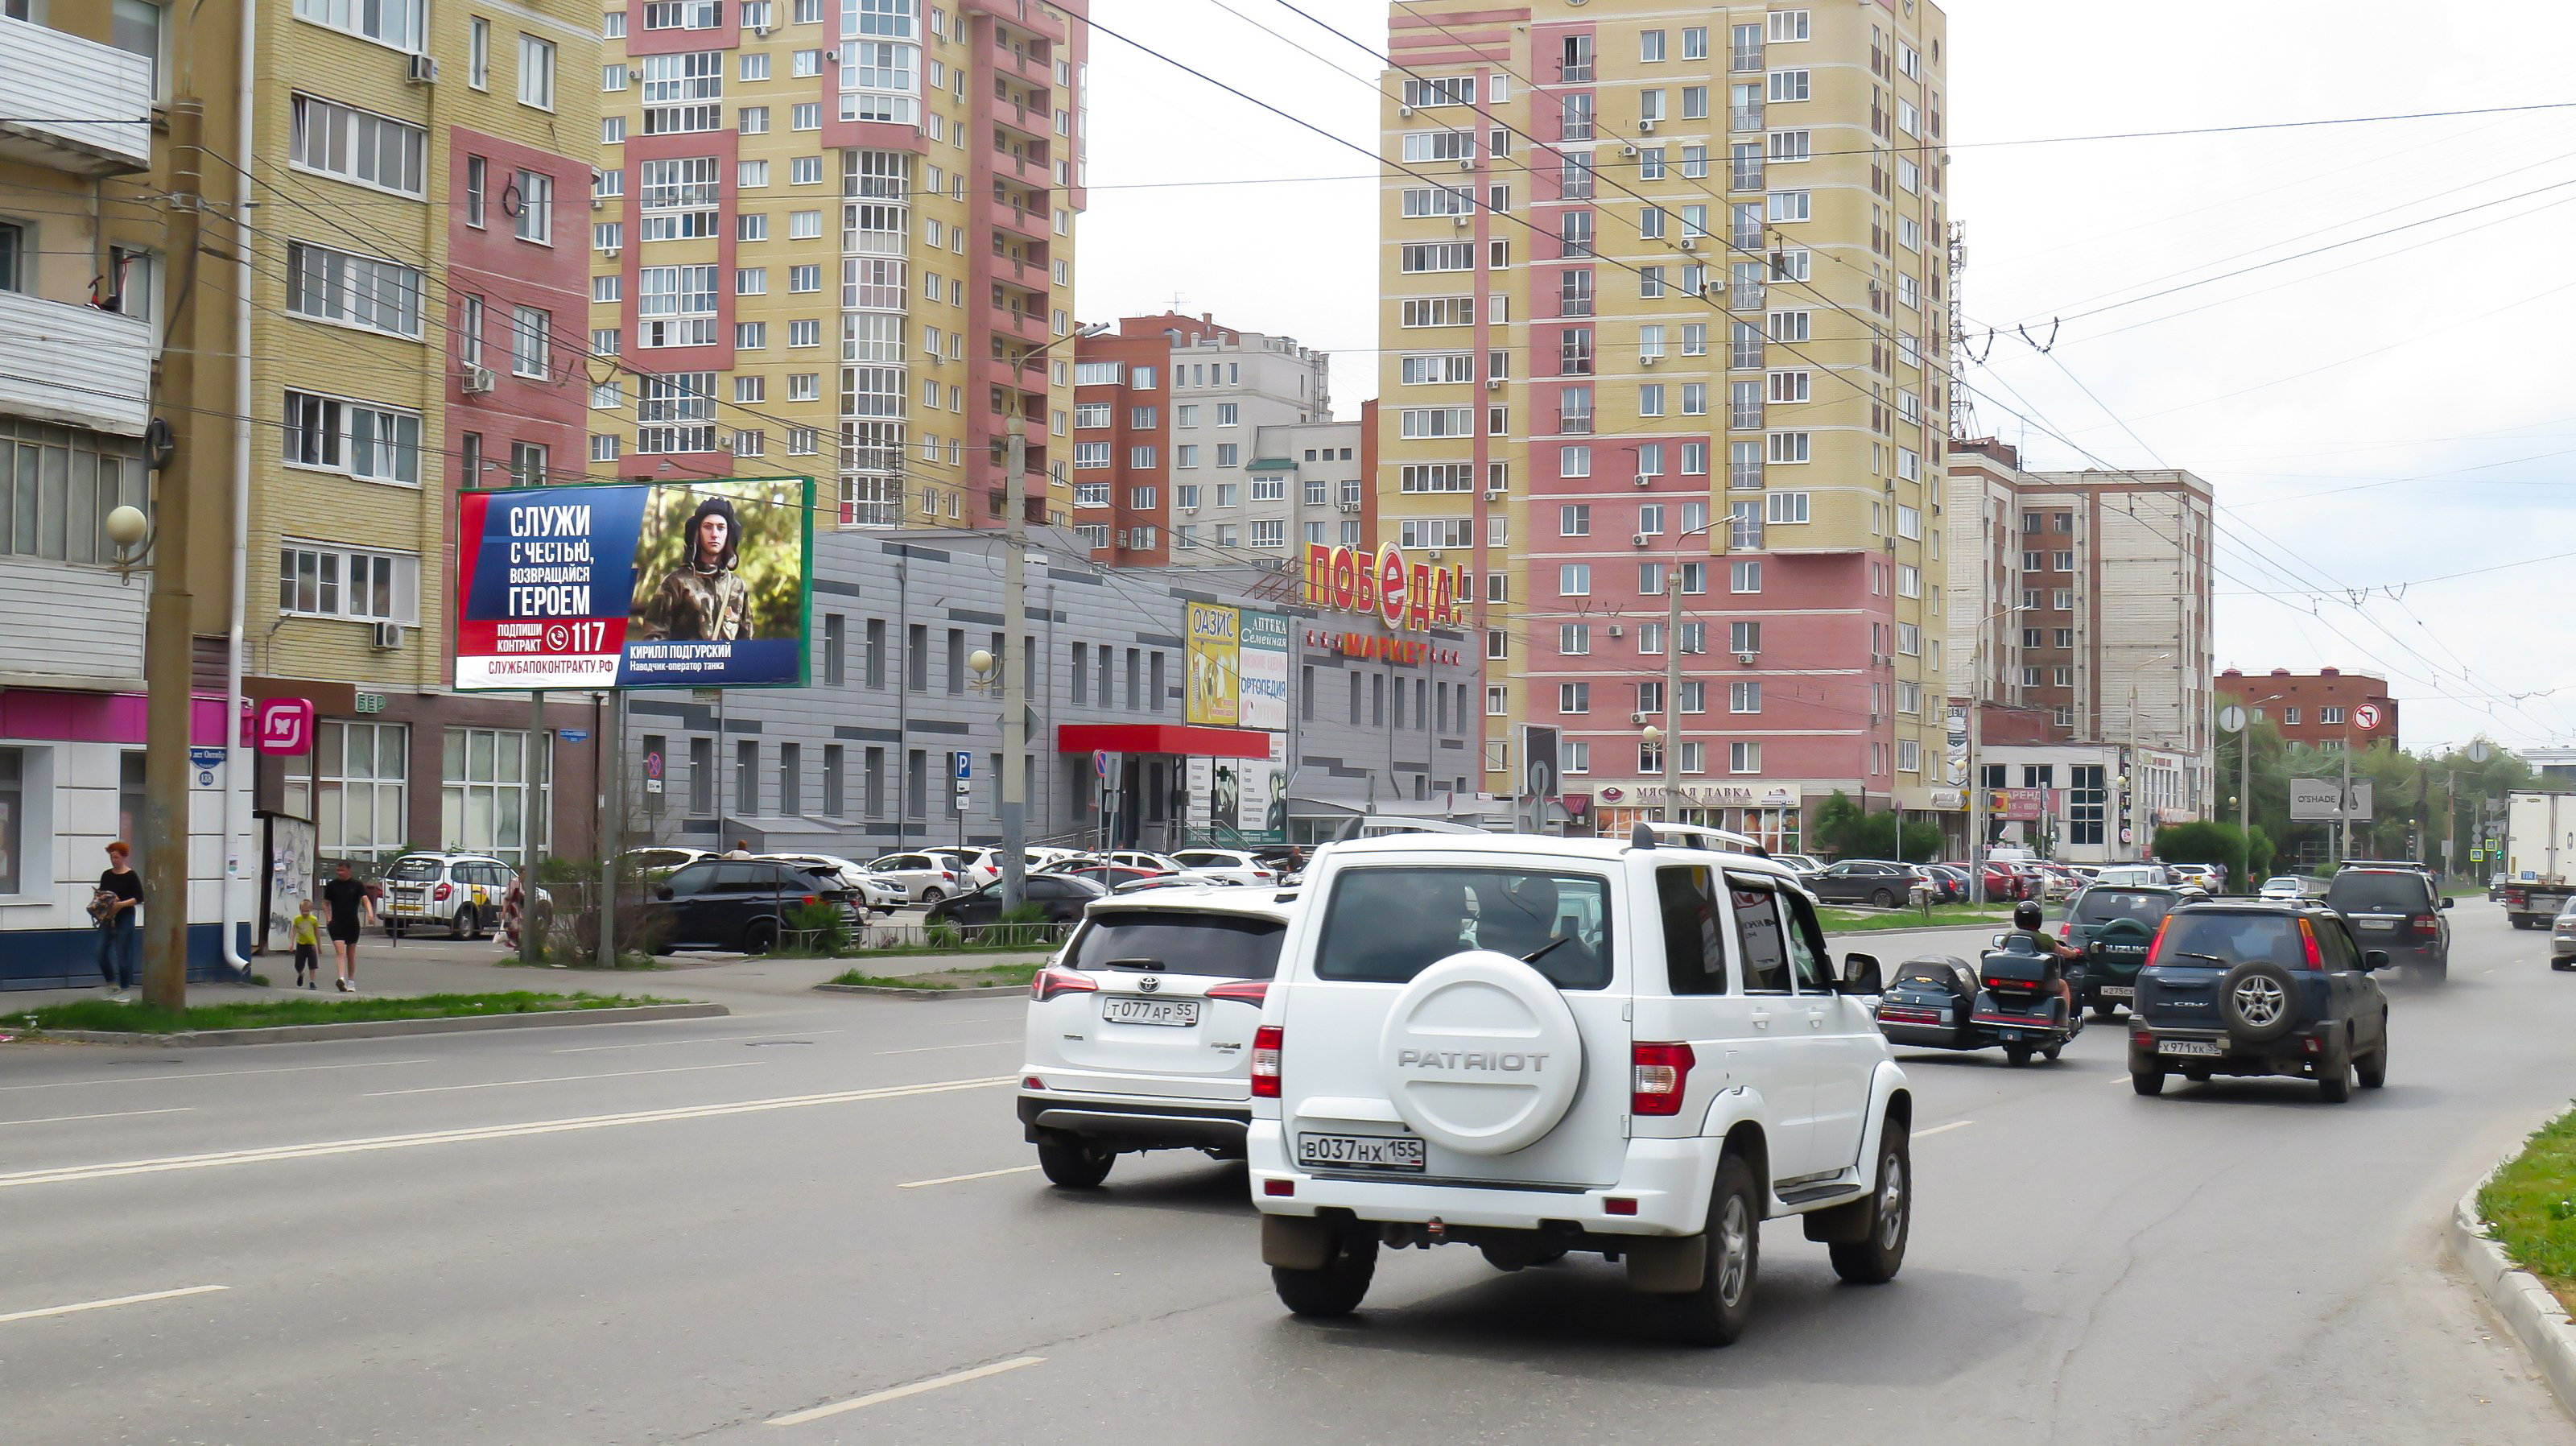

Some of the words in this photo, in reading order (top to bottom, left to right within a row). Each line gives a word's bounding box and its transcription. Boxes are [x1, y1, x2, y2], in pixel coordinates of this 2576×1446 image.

[510, 505, 591, 537] СЛУЖИ
[510, 541, 521, 564] С
[524, 539, 595, 564] ЧЕСТЬЮ,
[510, 564, 590, 584] ВОЗВРАЩАЙСЯ
[509, 585, 590, 617] ГЕРОЕМ
[497, 623, 543, 637] ПОДПИШИ
[1193, 607, 1235, 639] ОАЗИС
[1253, 617, 1286, 634] АПТЕКА
[497, 638, 542, 652] КОНТРАКТ
[572, 622, 605, 652] 117
[1241, 628, 1286, 647] Семейная
[630, 645, 667, 659] КИРИЛЛ
[670, 642, 732, 659] ПОДГУРСКИЙ
[1343, 632, 1428, 664] МАРКЕТ
[489, 659, 613, 675] СЛУЖБАПОКОНТРАКТУ.РФ
[630, 660, 702, 672] Наводчик-оператор
[704, 662, 724, 671] танка
[1241, 677, 1286, 699] ОРТОПЕДИЯ
[1637, 787, 1696, 797] МЯСАЯ
[1704, 787, 1752, 797] ЛАВКА
[1176, 1003, 1191, 1016] 55
[1398, 1047, 1550, 1072] PATRIOT
[1306, 1138, 1383, 1162] В037НХ
[1387, 1140, 1417, 1157] 155
